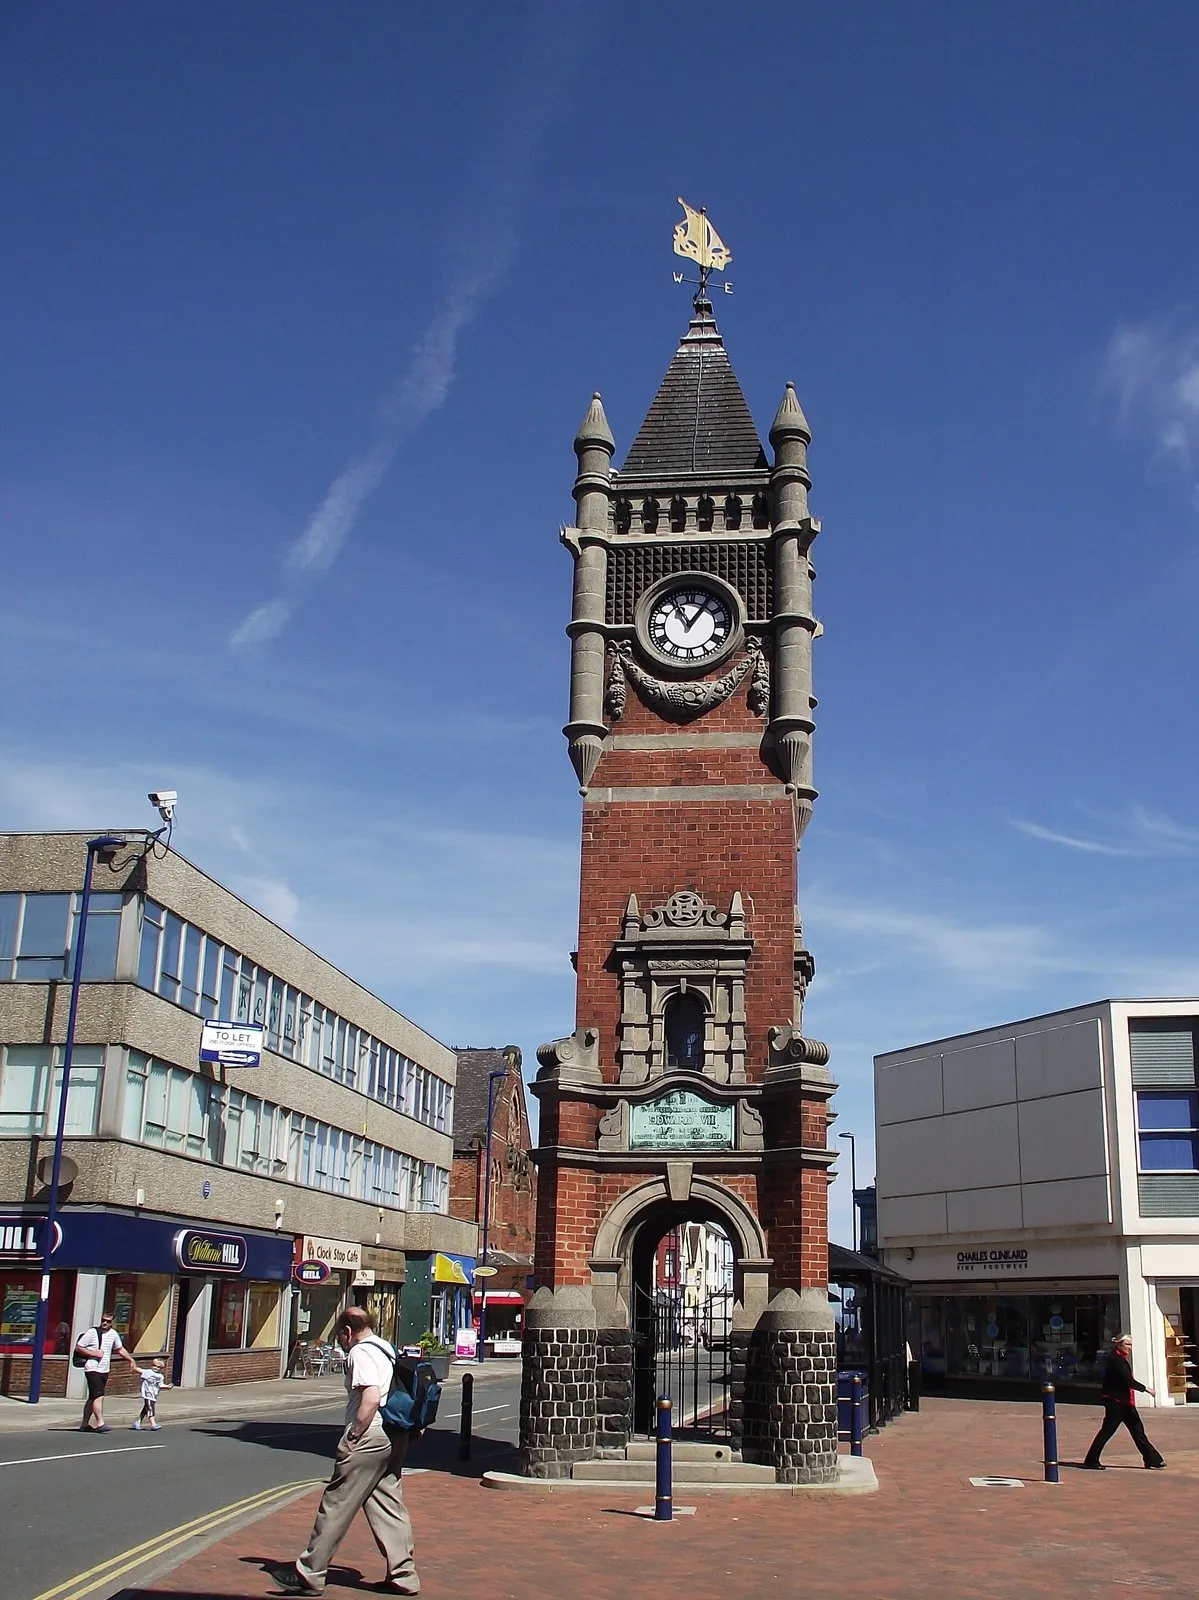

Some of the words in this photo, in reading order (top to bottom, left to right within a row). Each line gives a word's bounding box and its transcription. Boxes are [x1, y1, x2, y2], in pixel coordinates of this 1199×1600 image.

[673, 272, 683, 283] W
[725, 282, 734, 293] E
[216, 1031, 229, 1040] TO
[232, 1033, 251, 1042] LET
[648, 1115, 694, 1125] EDWARD
[188, 1235, 222, 1263] William
[221, 1243, 239, 1264] HILL
[316, 1246, 332, 1260] Clock
[333, 1248, 346, 1264] Stop
[346, 1250, 358, 1263] Cafe
[957, 1251, 988, 1262] CHARLES
[989, 1249, 1028, 1260] CLINKARD
[302, 1270, 321, 1279] HILL
